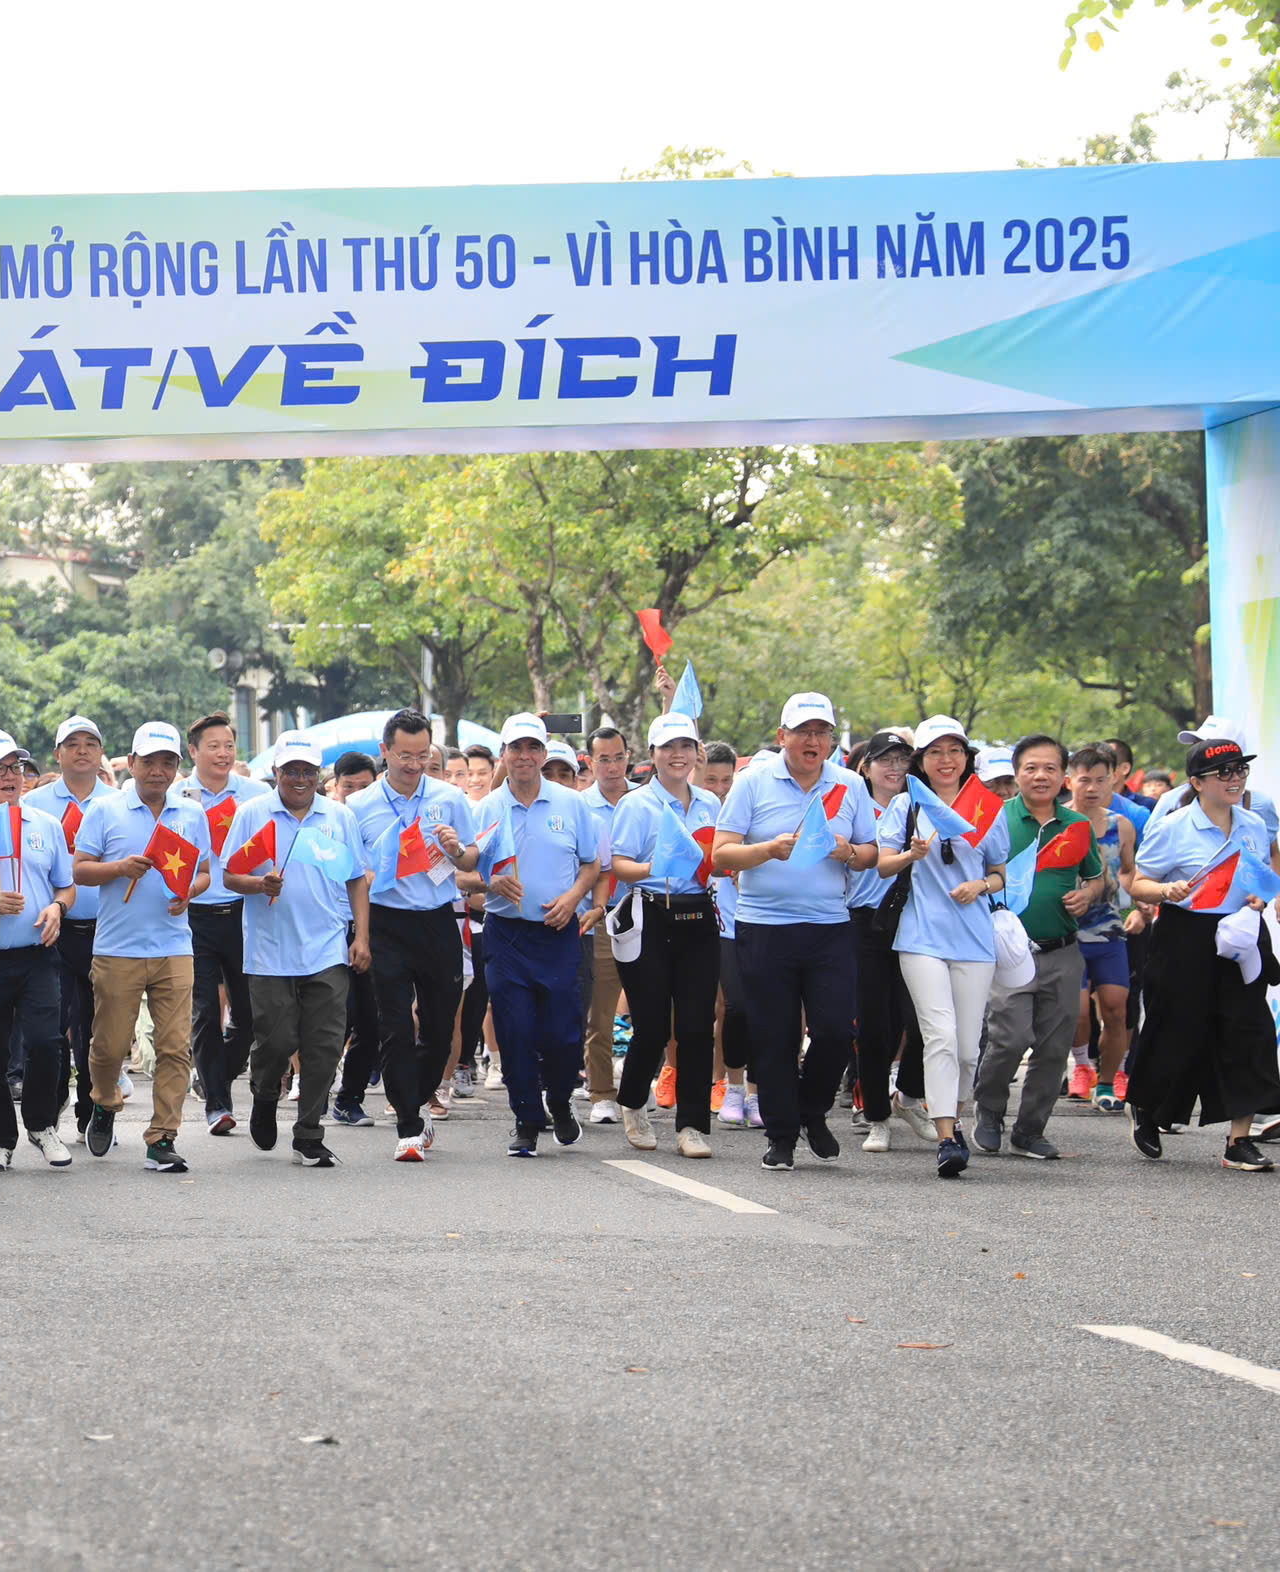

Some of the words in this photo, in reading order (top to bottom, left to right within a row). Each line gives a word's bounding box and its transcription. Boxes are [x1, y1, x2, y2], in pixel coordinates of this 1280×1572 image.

[89, 231, 219, 309] RỘNG
[235, 221, 328, 295] LẦN
[342, 224, 440, 292] THỨ
[455, 233, 516, 290] 50
[532, 255, 551, 266] -
[566, 219, 612, 287] VÌ
[629, 218, 729, 286] HÒA
[743, 216, 859, 282] BÌNH
[876, 211, 985, 280] NĂM
[1002, 214, 1131, 275] 2025
[409, 313, 738, 403] ĐÍCH
